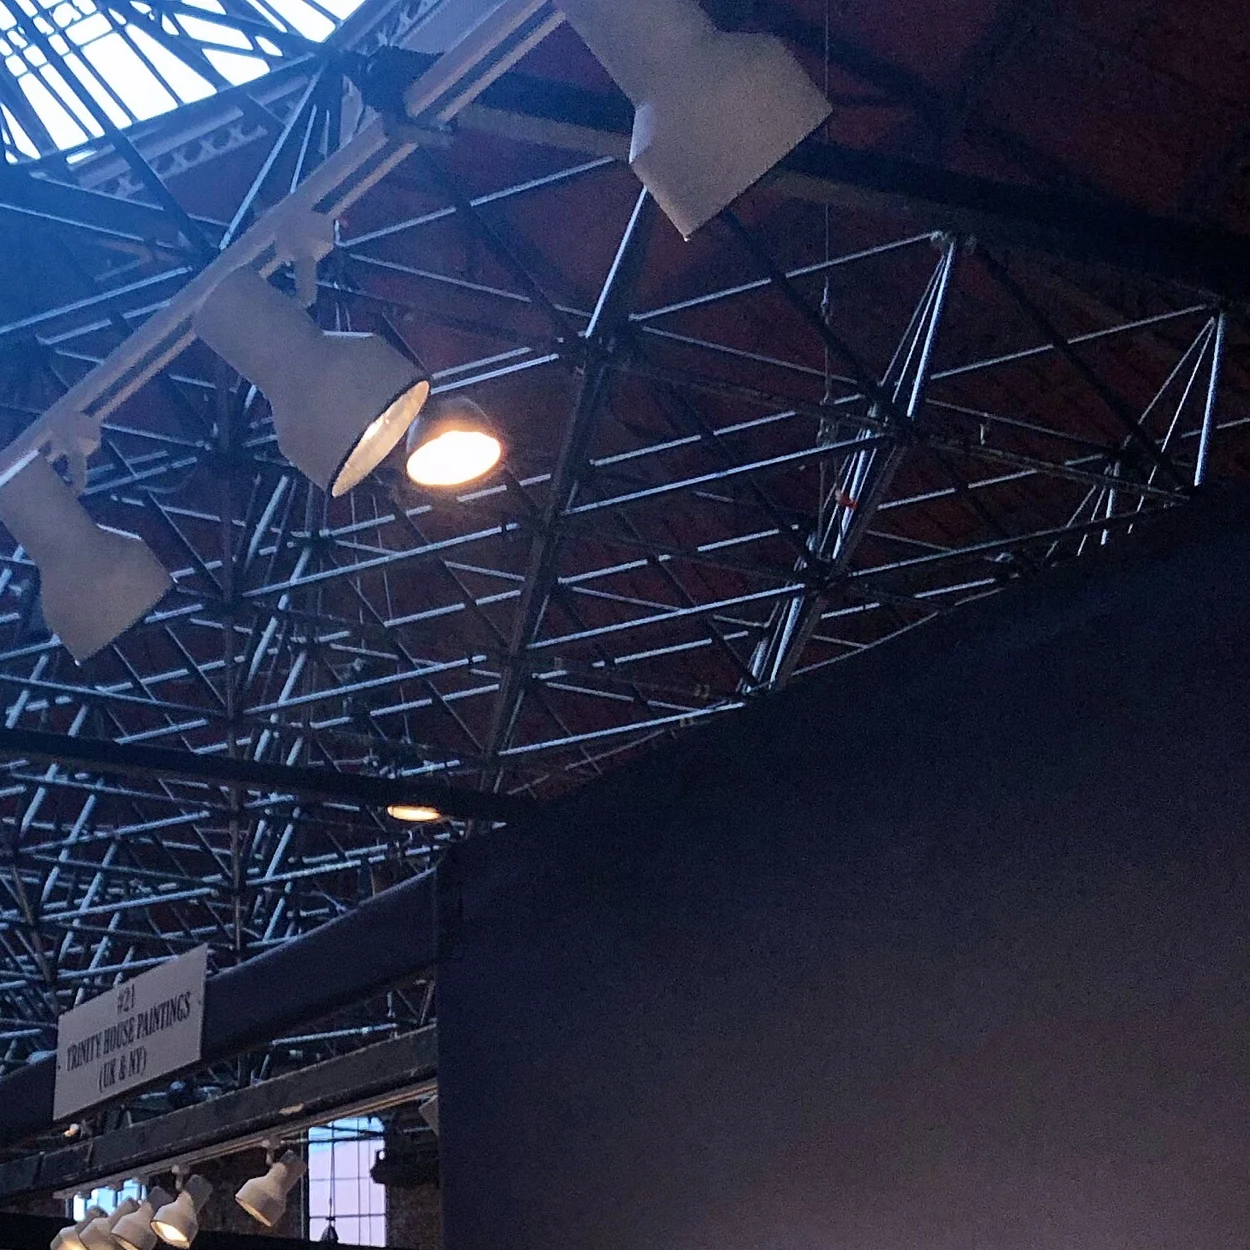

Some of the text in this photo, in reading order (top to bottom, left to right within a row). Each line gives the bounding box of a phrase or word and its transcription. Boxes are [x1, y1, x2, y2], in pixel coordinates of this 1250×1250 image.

[117, 984, 135, 1014] #21
[66, 990, 191, 1072] TRINITY HOUSE PAINTINGS
[99, 1045, 147, 1093] (UK & NY)
